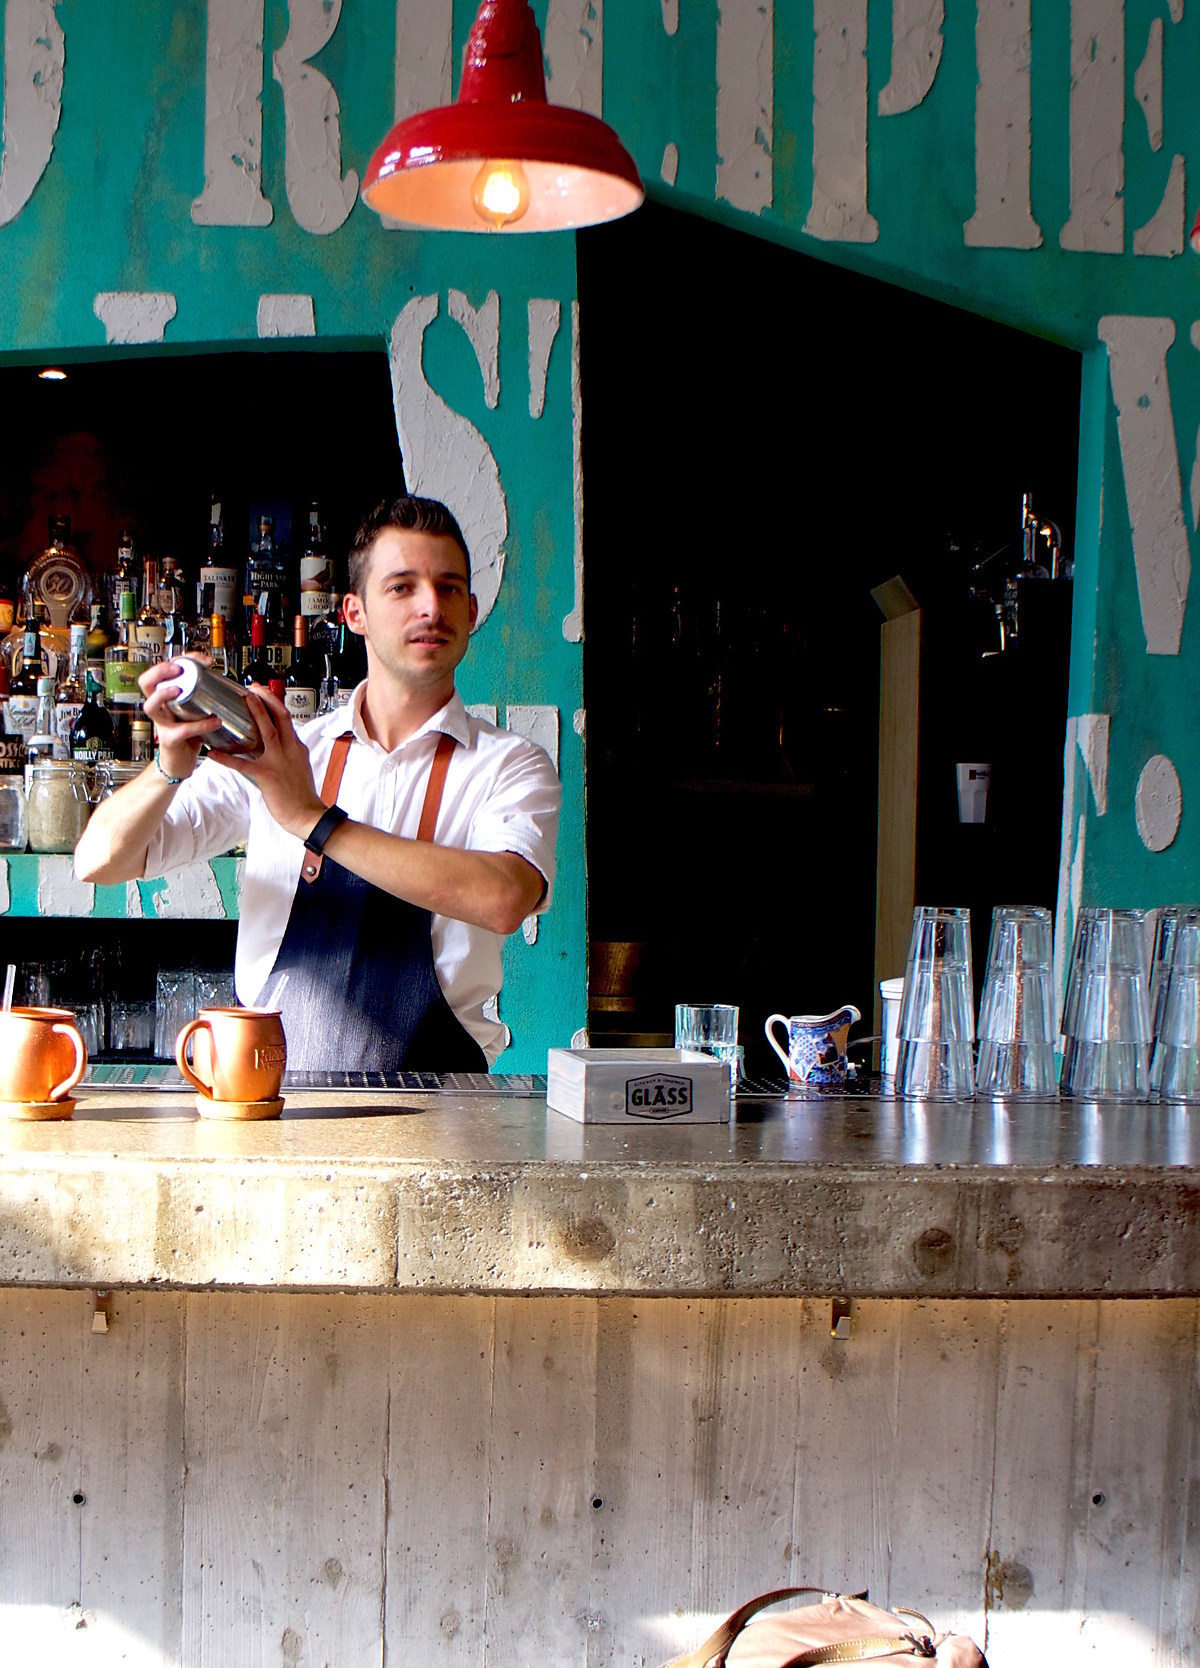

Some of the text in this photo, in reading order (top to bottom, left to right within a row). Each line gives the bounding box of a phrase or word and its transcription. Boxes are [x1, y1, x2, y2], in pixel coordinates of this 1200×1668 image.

[74, 751, 97, 760] NOILLY
[98, 751, 114, 760] PRAT
[631, 1084, 688, 1107] GLASS
